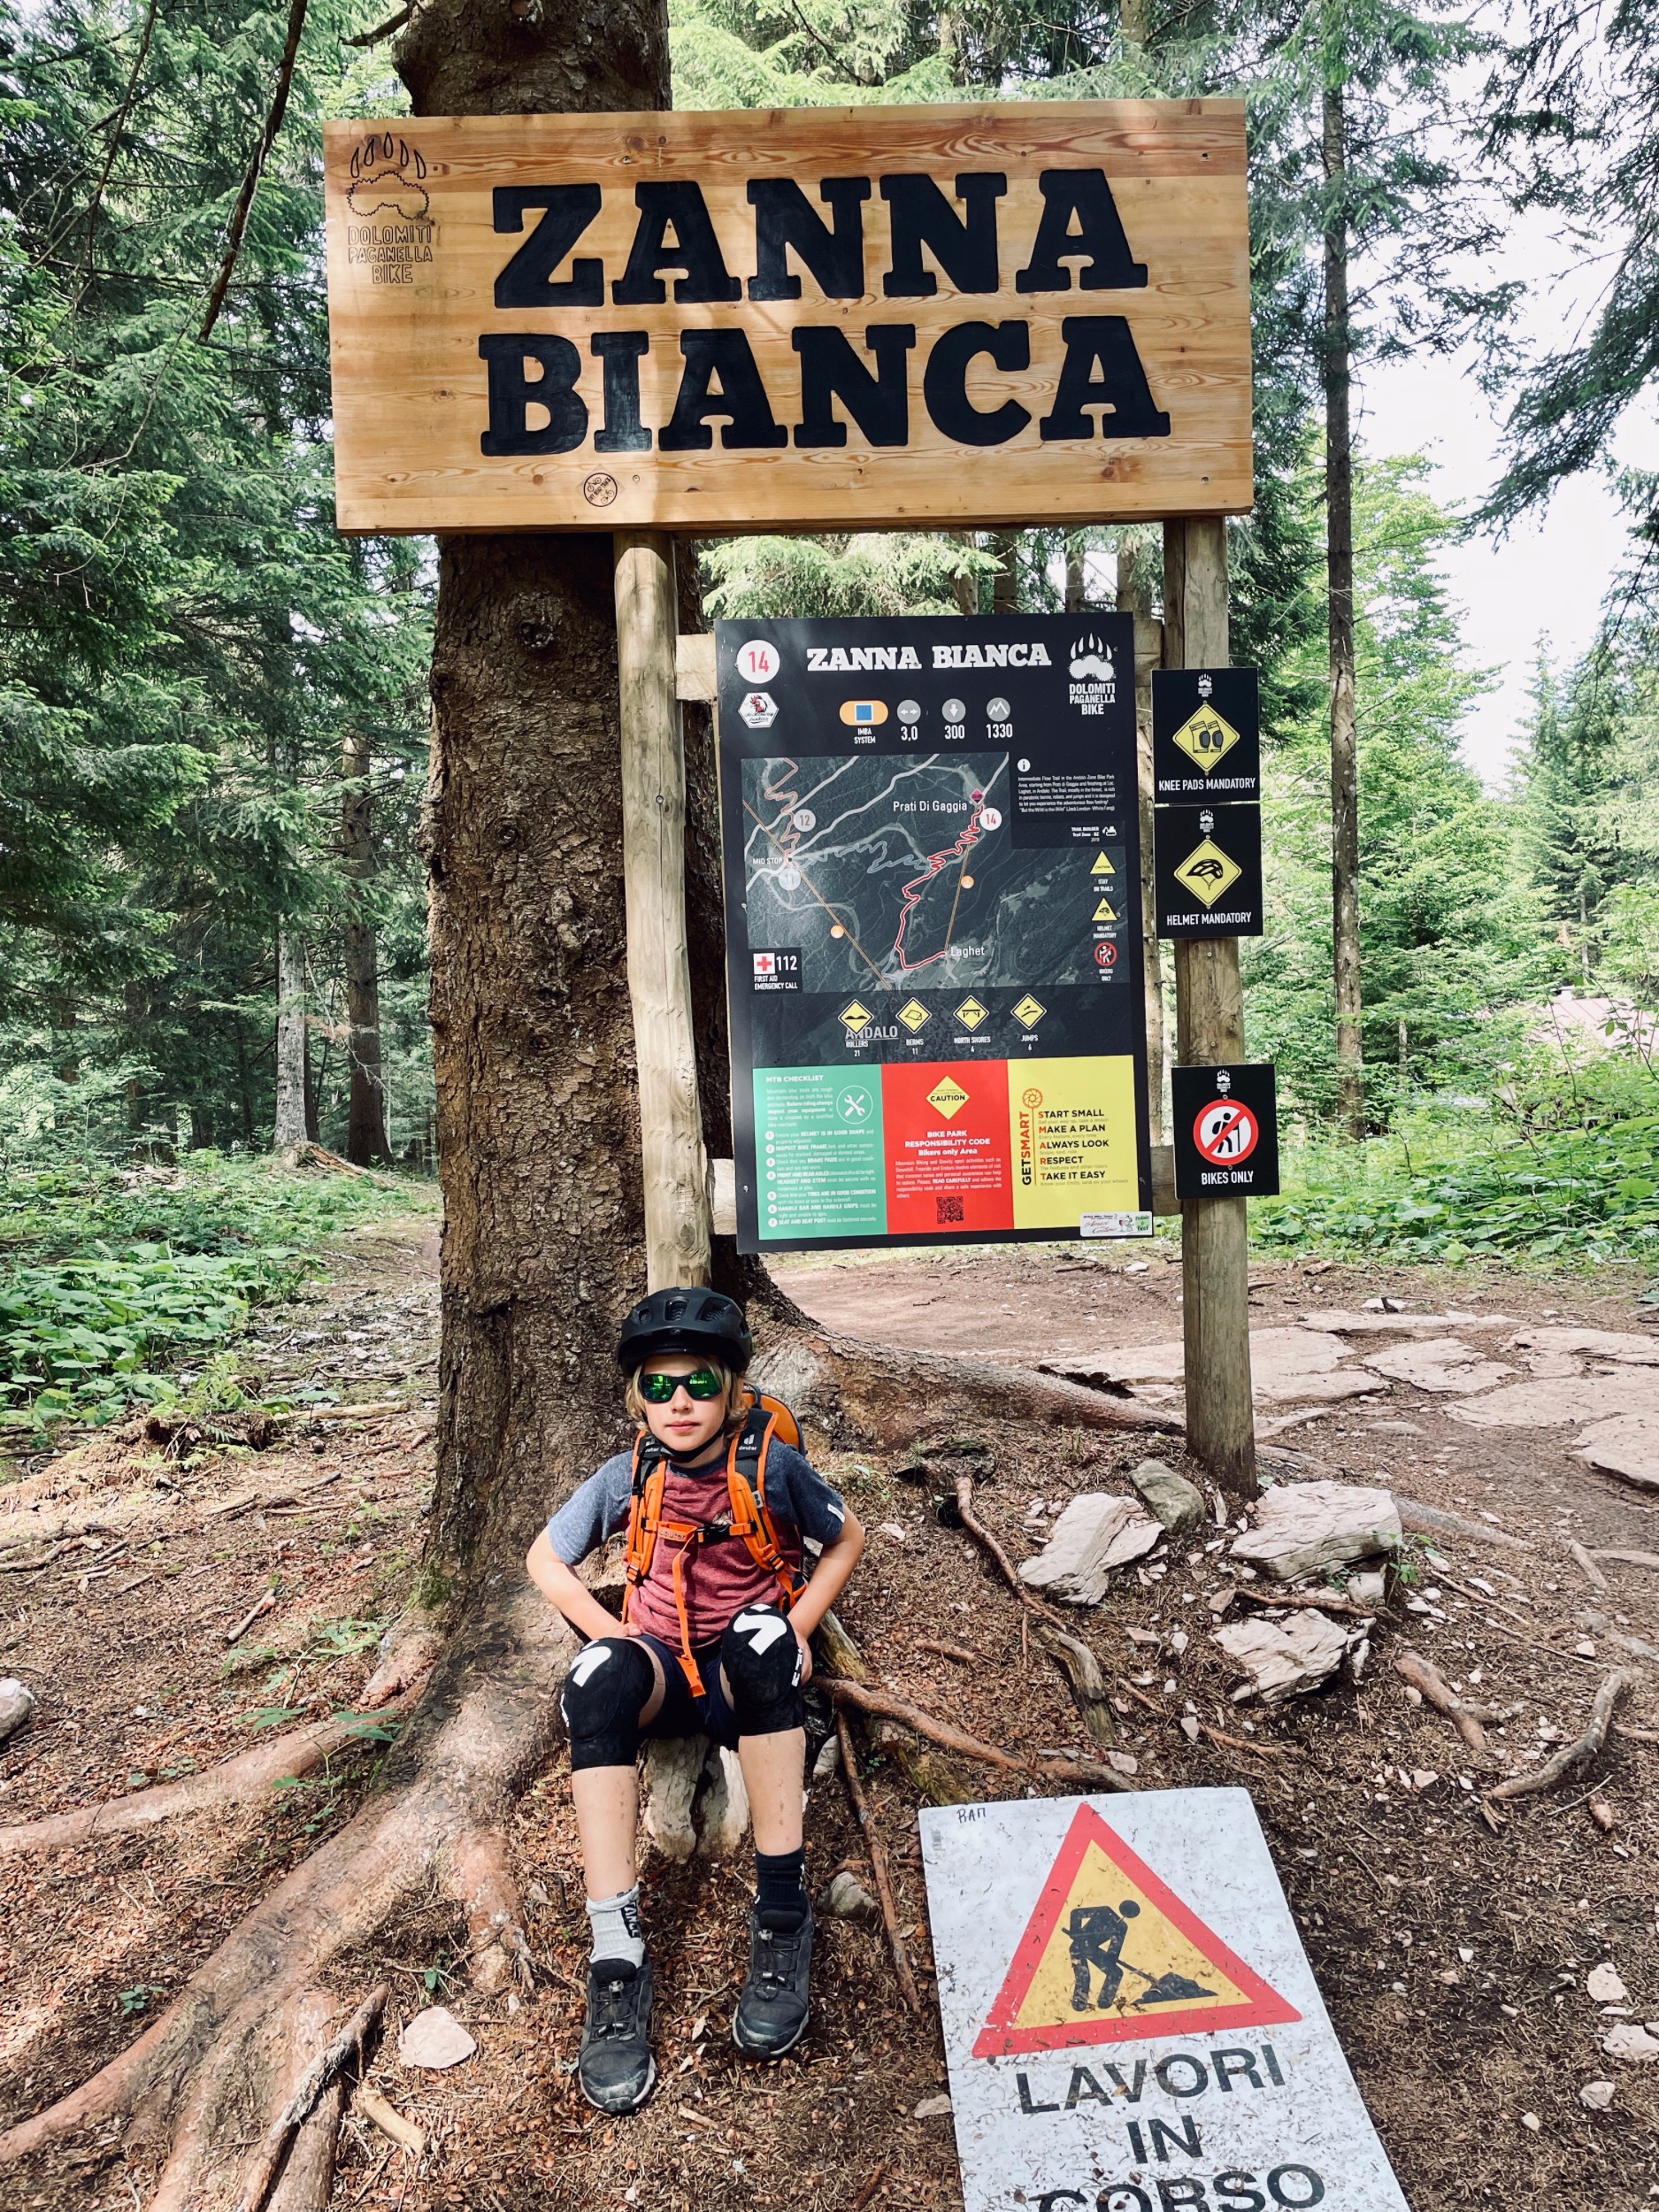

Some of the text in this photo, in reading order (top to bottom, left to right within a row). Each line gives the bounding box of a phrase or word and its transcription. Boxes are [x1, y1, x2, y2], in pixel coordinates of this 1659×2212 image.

[348, 225, 431, 245] DOLOMITI
[492, 168, 1148, 309] ZANNA
[348, 246, 433, 264] PAGANELLA
[372, 264, 413, 284] BIKE
[479, 315, 1171, 457] BIANCA
[748, 650, 769, 673] 14
[807, 643, 1052, 671] ZANNA BIANCA
[1069, 683, 1115, 695] DOLOMITI
[1069, 695, 1115, 704] PAGANELLA
[1081, 704, 1104, 715] BIKE
[900, 726, 918, 741] 3,0
[944, 725, 965, 739] 300
[986, 724, 1013, 738] 1330
[1159, 778, 1255, 791] KNEE PADS MANDATORY
[893, 800, 967, 813] Prati Di Gaggia
[800, 815, 810, 826] 12
[986, 814, 997, 825] 14
[1167, 912, 1251, 926] HELMET MANDATORY
[951, 946, 985, 958] Laghet
[776, 955, 797, 971] 112
[845, 1026, 897, 1039] ANDALO
[905, 1139, 967, 1147] RESPONSIBILITY
[1019, 1111, 1031, 1185] GETSMART
[1040, 1156, 1083, 1165] RESPECT
[1201, 1171, 1254, 1185] BIKES ONLY
[1016, 2044, 1286, 2115] LAVORI
[1126, 2114, 1204, 2164] IN
